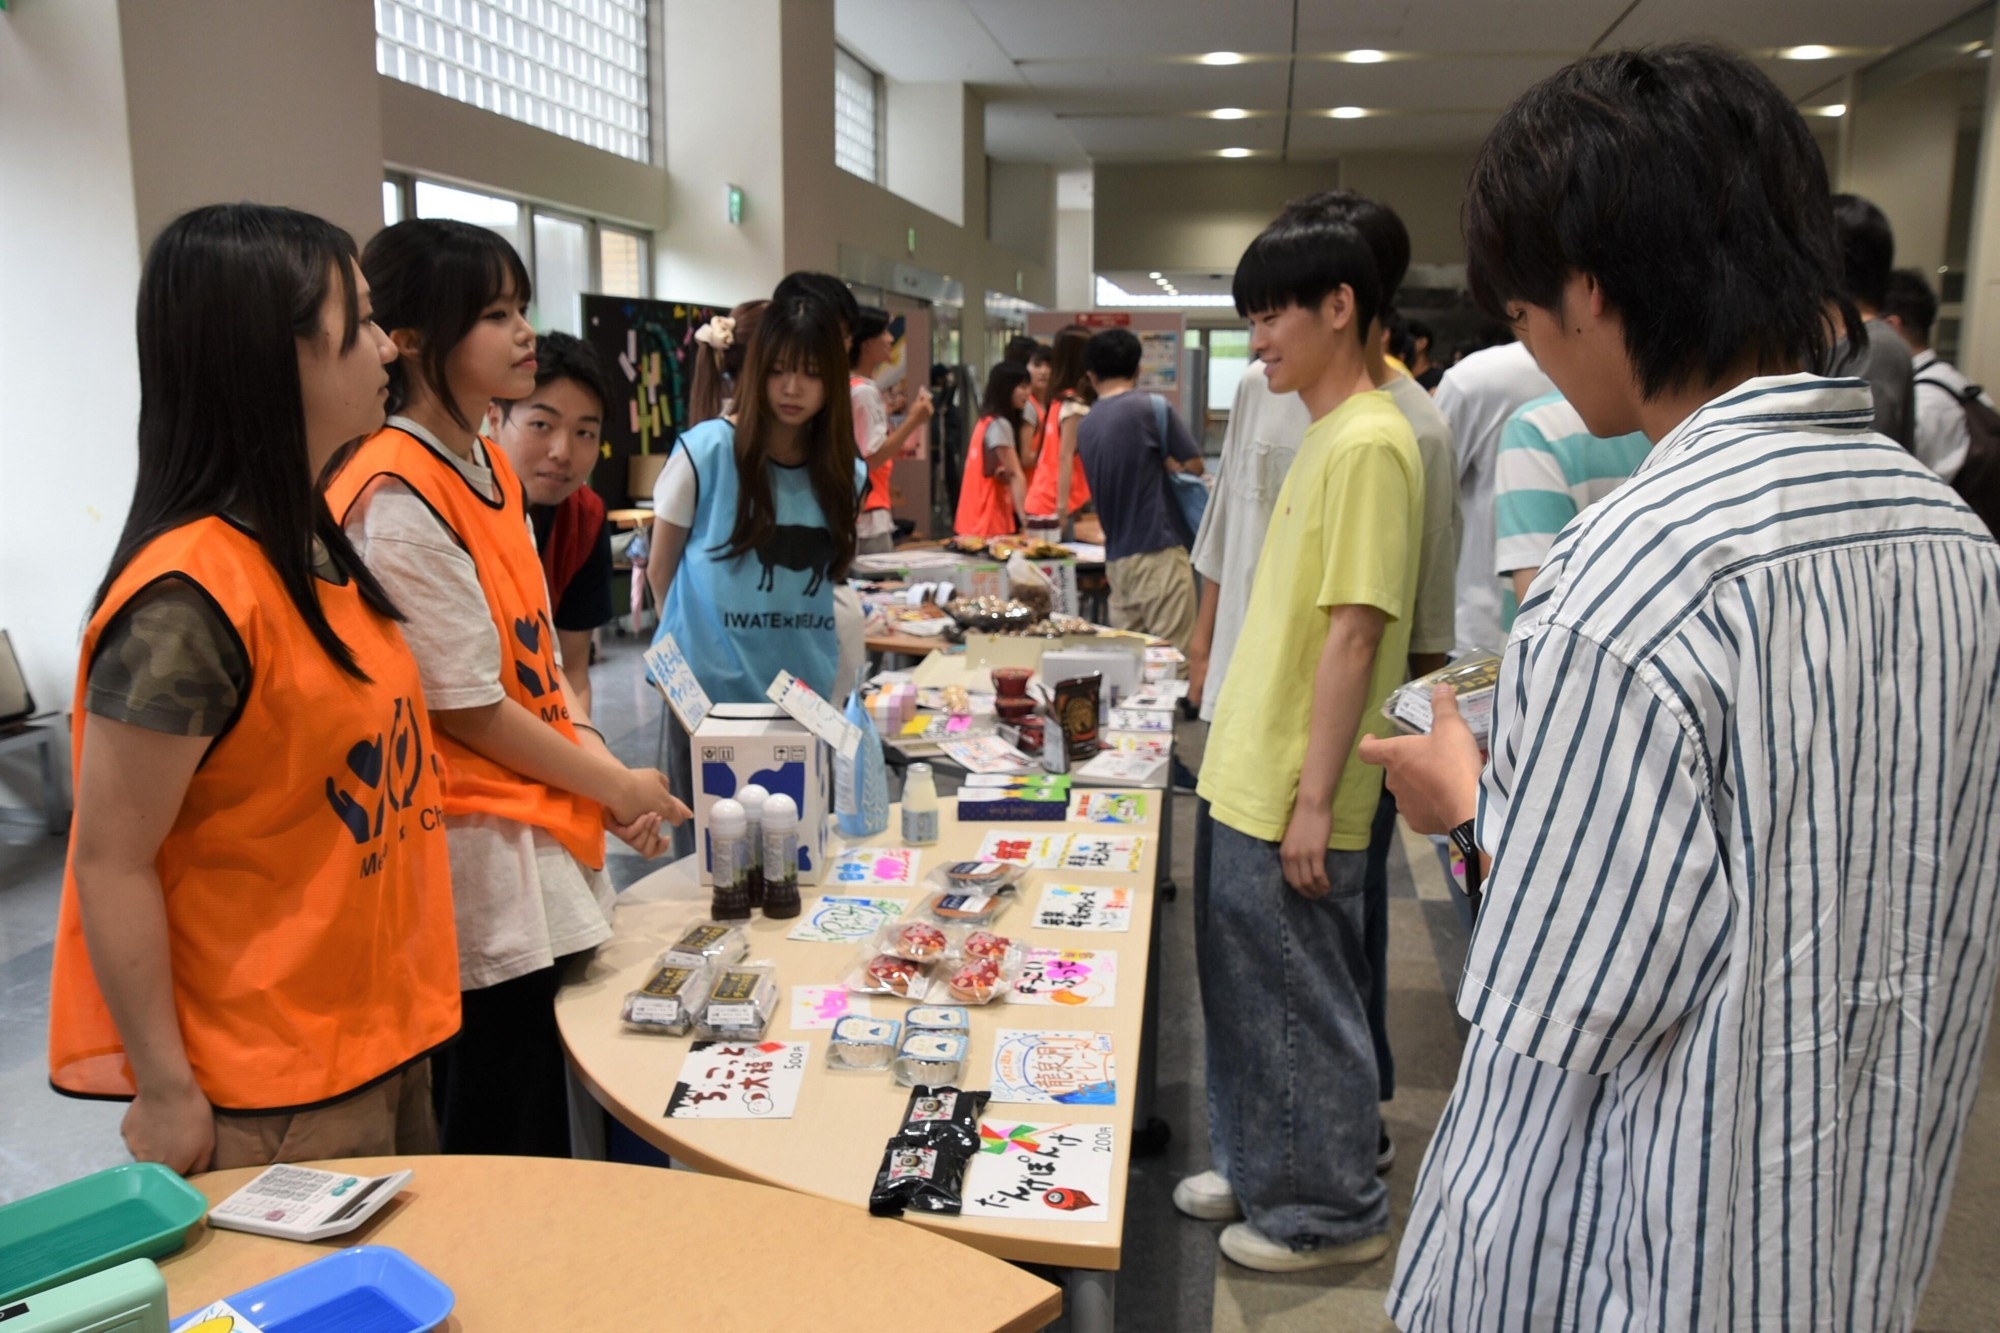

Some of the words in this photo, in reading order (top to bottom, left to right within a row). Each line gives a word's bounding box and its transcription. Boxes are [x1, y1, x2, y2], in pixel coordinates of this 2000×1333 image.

[784, 1046, 803, 1069] 500円
[688, 1047, 746, 1105] ちょこっと
[738, 1061, 773, 1090] 大福
[1093, 1127, 1111, 1153] 200円
